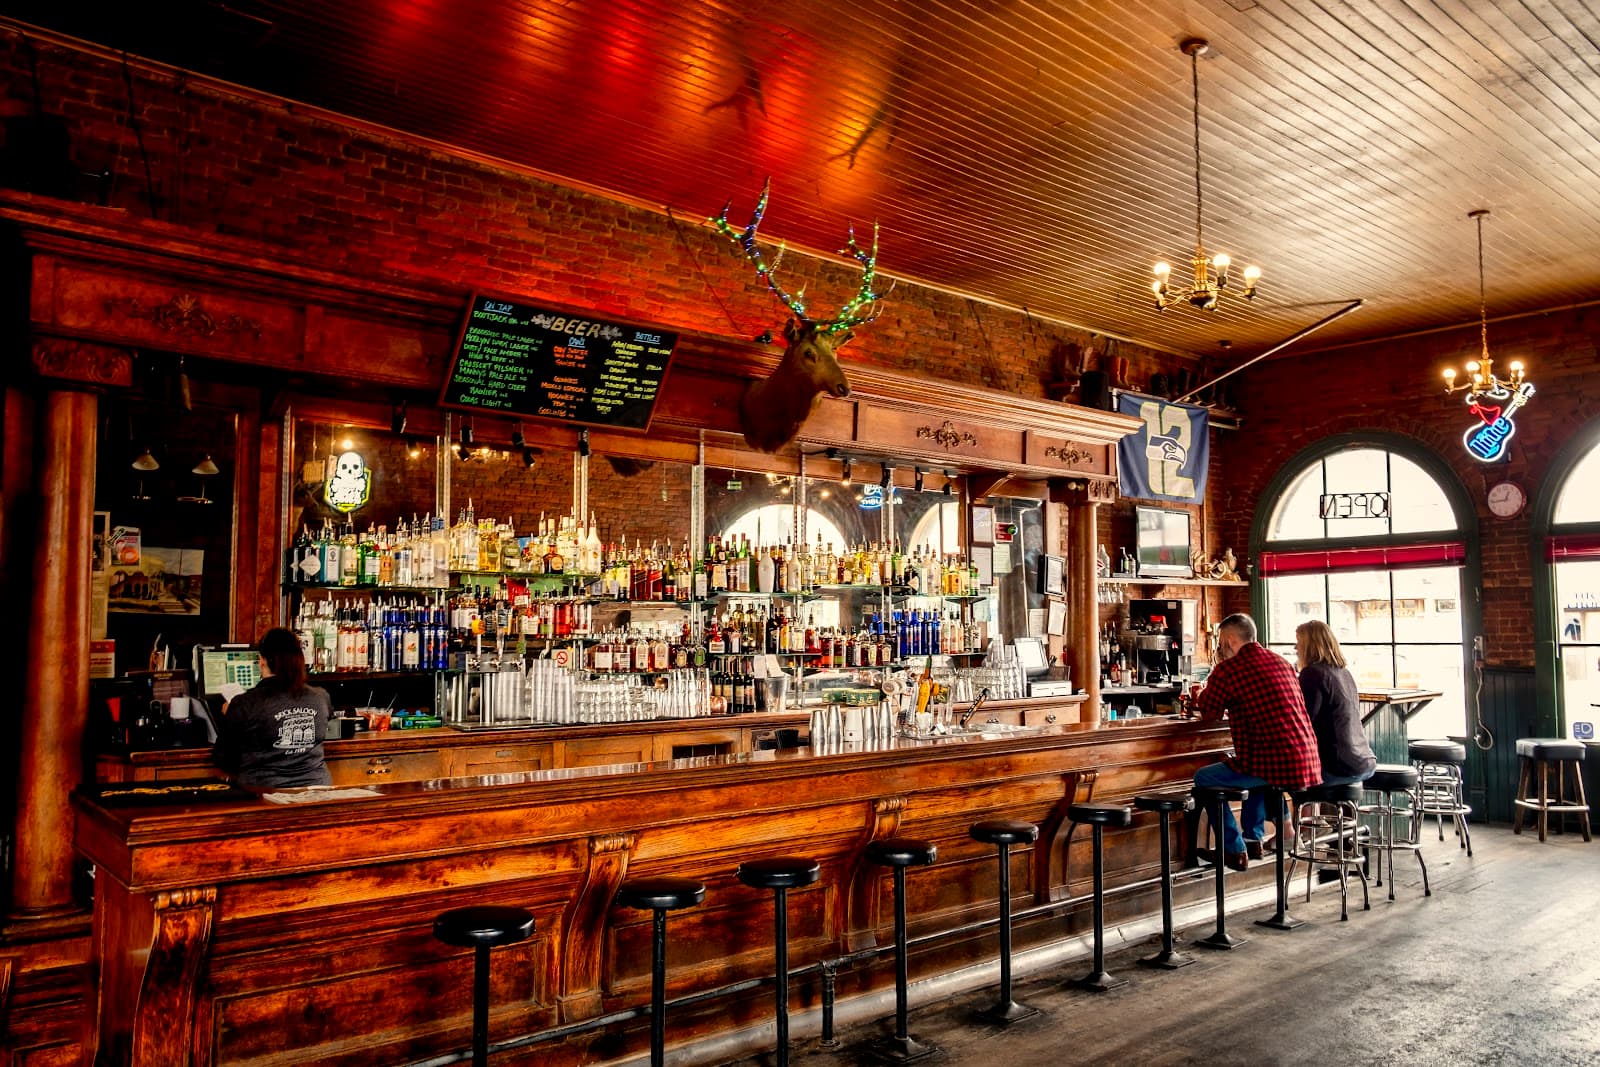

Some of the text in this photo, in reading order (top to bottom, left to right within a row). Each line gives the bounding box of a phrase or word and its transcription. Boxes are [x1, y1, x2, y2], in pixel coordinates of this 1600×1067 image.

[497, 303, 513, 312] TAP
[550, 317, 601, 338] BEER
[635, 331, 661, 343] BOTTLES
[494, 364, 524, 374] PILSNER
[489, 371, 503, 380] PALE
[504, 373, 518, 381] ALE
[482, 399, 502, 408] LIGHT
[1140, 401, 1195, 498] 12
[292, 707, 318, 717] SALOON
